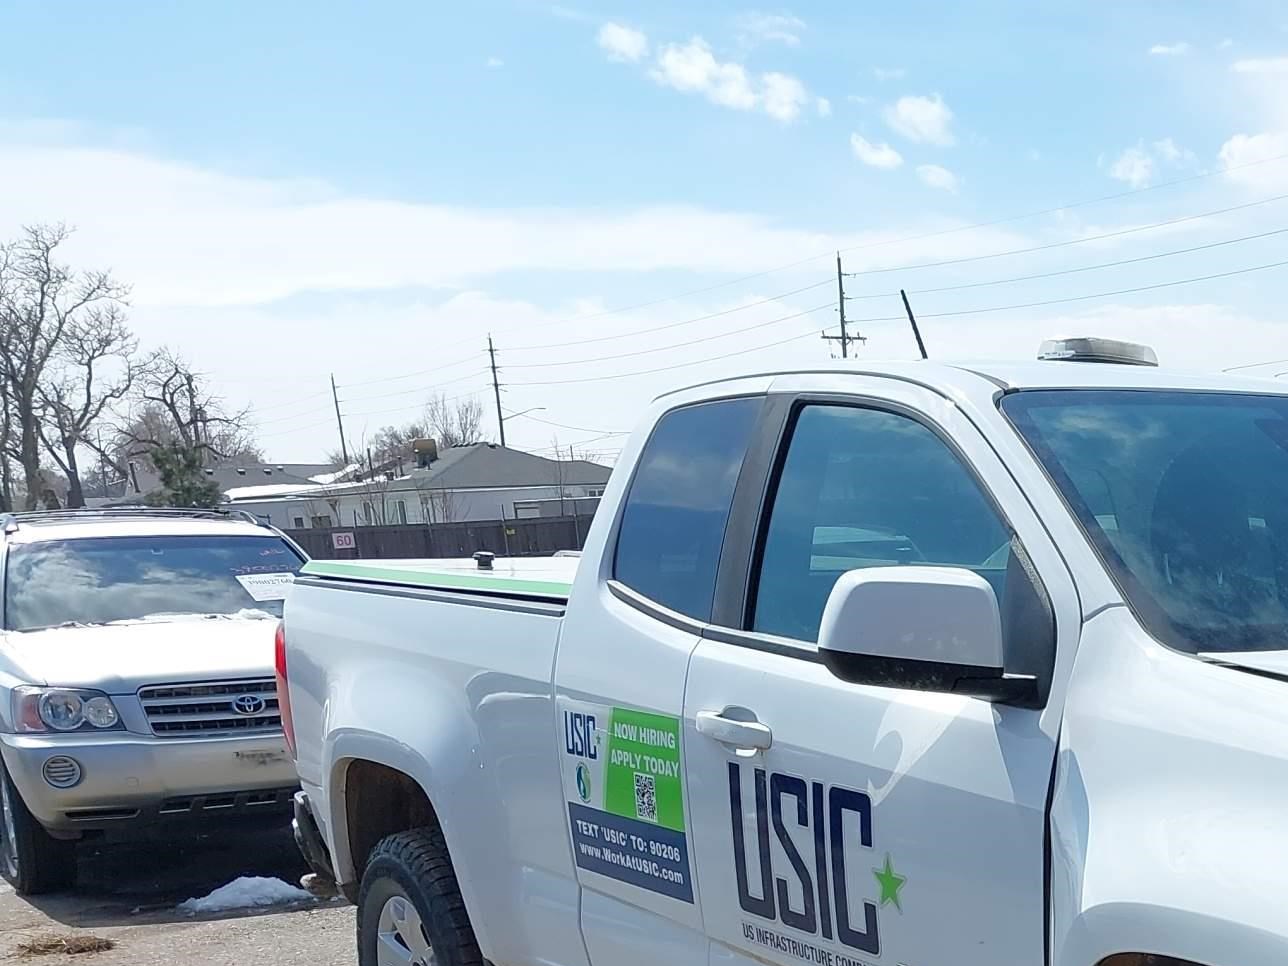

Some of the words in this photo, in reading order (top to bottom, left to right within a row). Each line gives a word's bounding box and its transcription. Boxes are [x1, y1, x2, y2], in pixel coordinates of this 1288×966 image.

[336, 535, 351, 545] 60
[564, 711, 598, 760] USIC
[614, 722, 637, 741] NOW
[639, 728, 676, 749] HIRING
[611, 749, 641, 769] APPLY
[643, 756, 679, 778] TODAY
[576, 820, 599, 838] TEXT
[601, 827, 628, 846] 'USIC'
[630, 835, 648, 852] TO:
[649, 841, 681, 862] 90206
[727, 761, 880, 956] USIC
[579, 843, 684, 884] www.WorkAtUSIC.com
[742, 923, 755, 940] US
